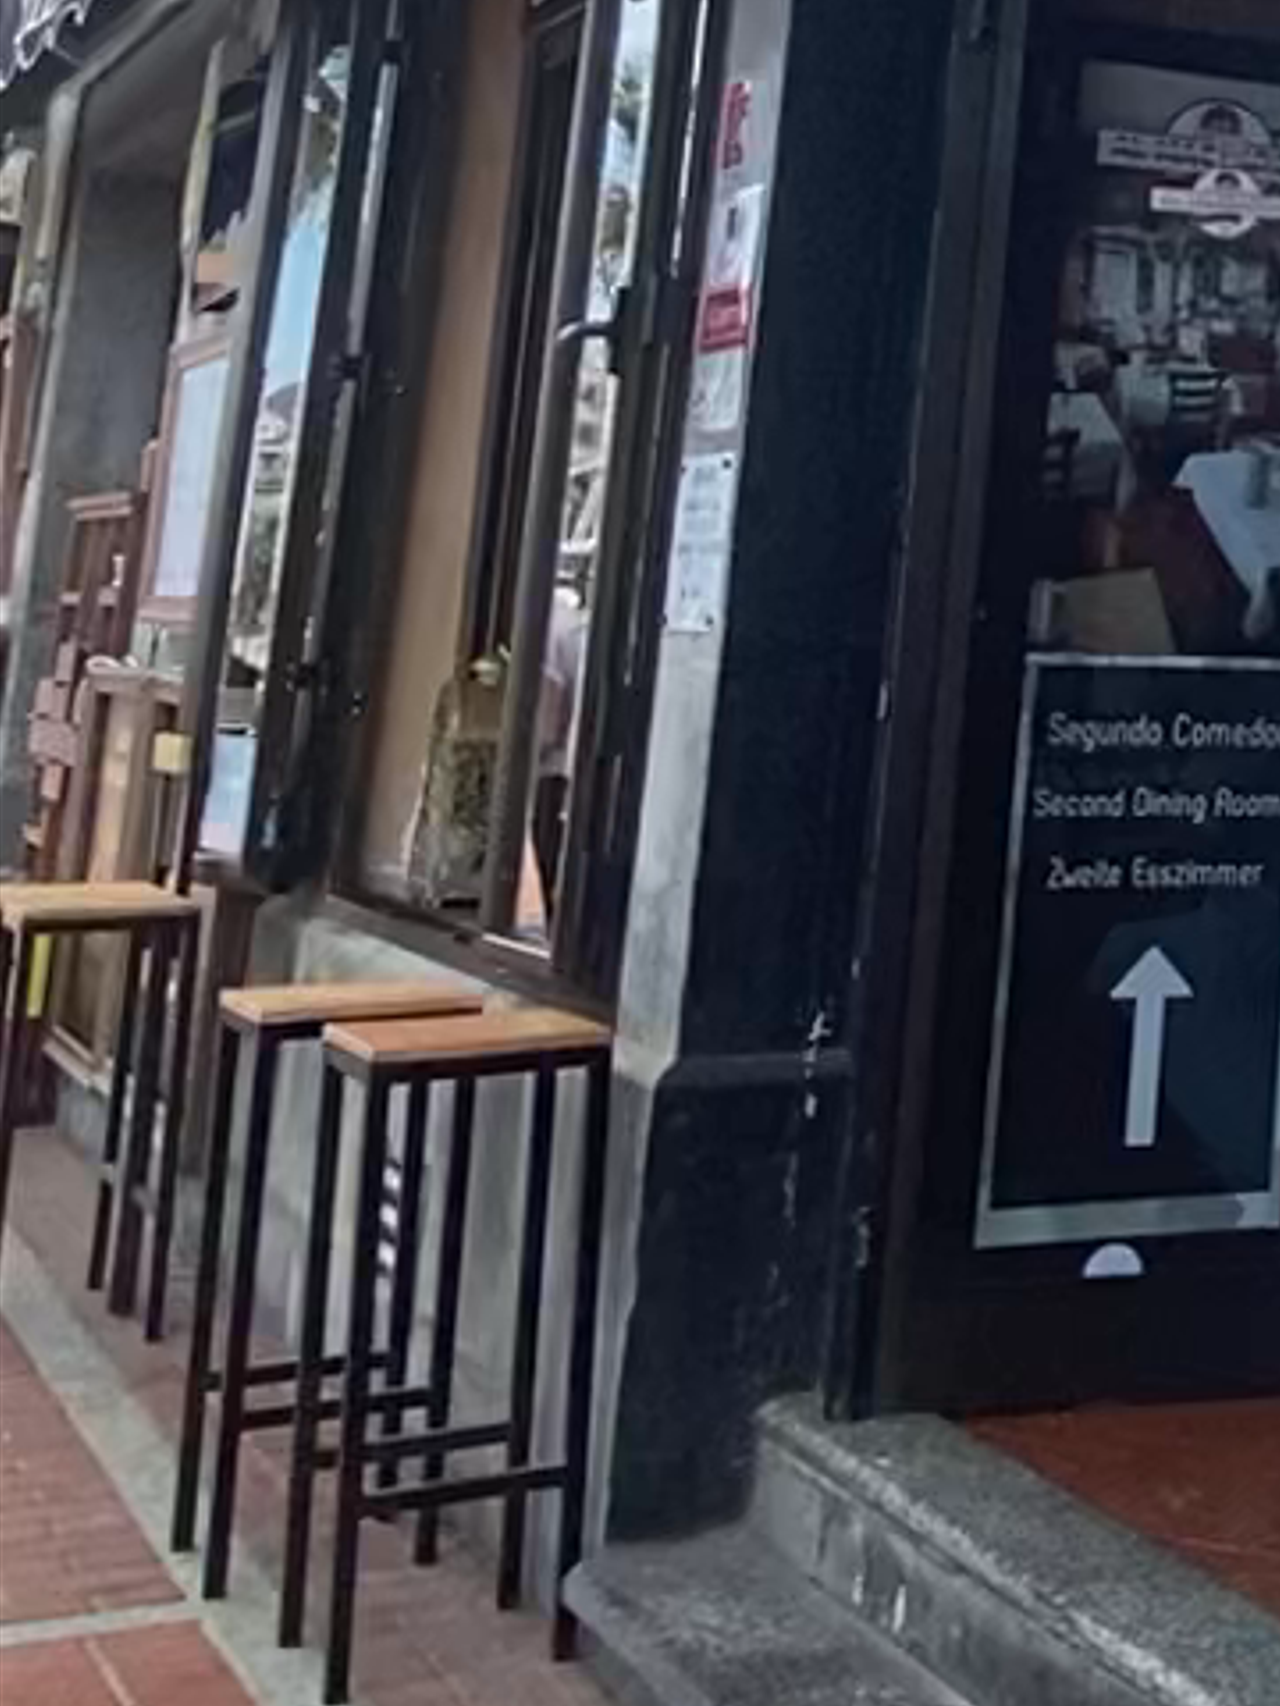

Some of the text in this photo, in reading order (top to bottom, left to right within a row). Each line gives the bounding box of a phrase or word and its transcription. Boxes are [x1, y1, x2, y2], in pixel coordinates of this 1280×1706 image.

[1047, 712, 1163, 753] Segundo
[1032, 788, 1126, 818] Second
[1132, 786, 1207, 824] Dining
[1046, 855, 1265, 890] Zweite Esszimmer
